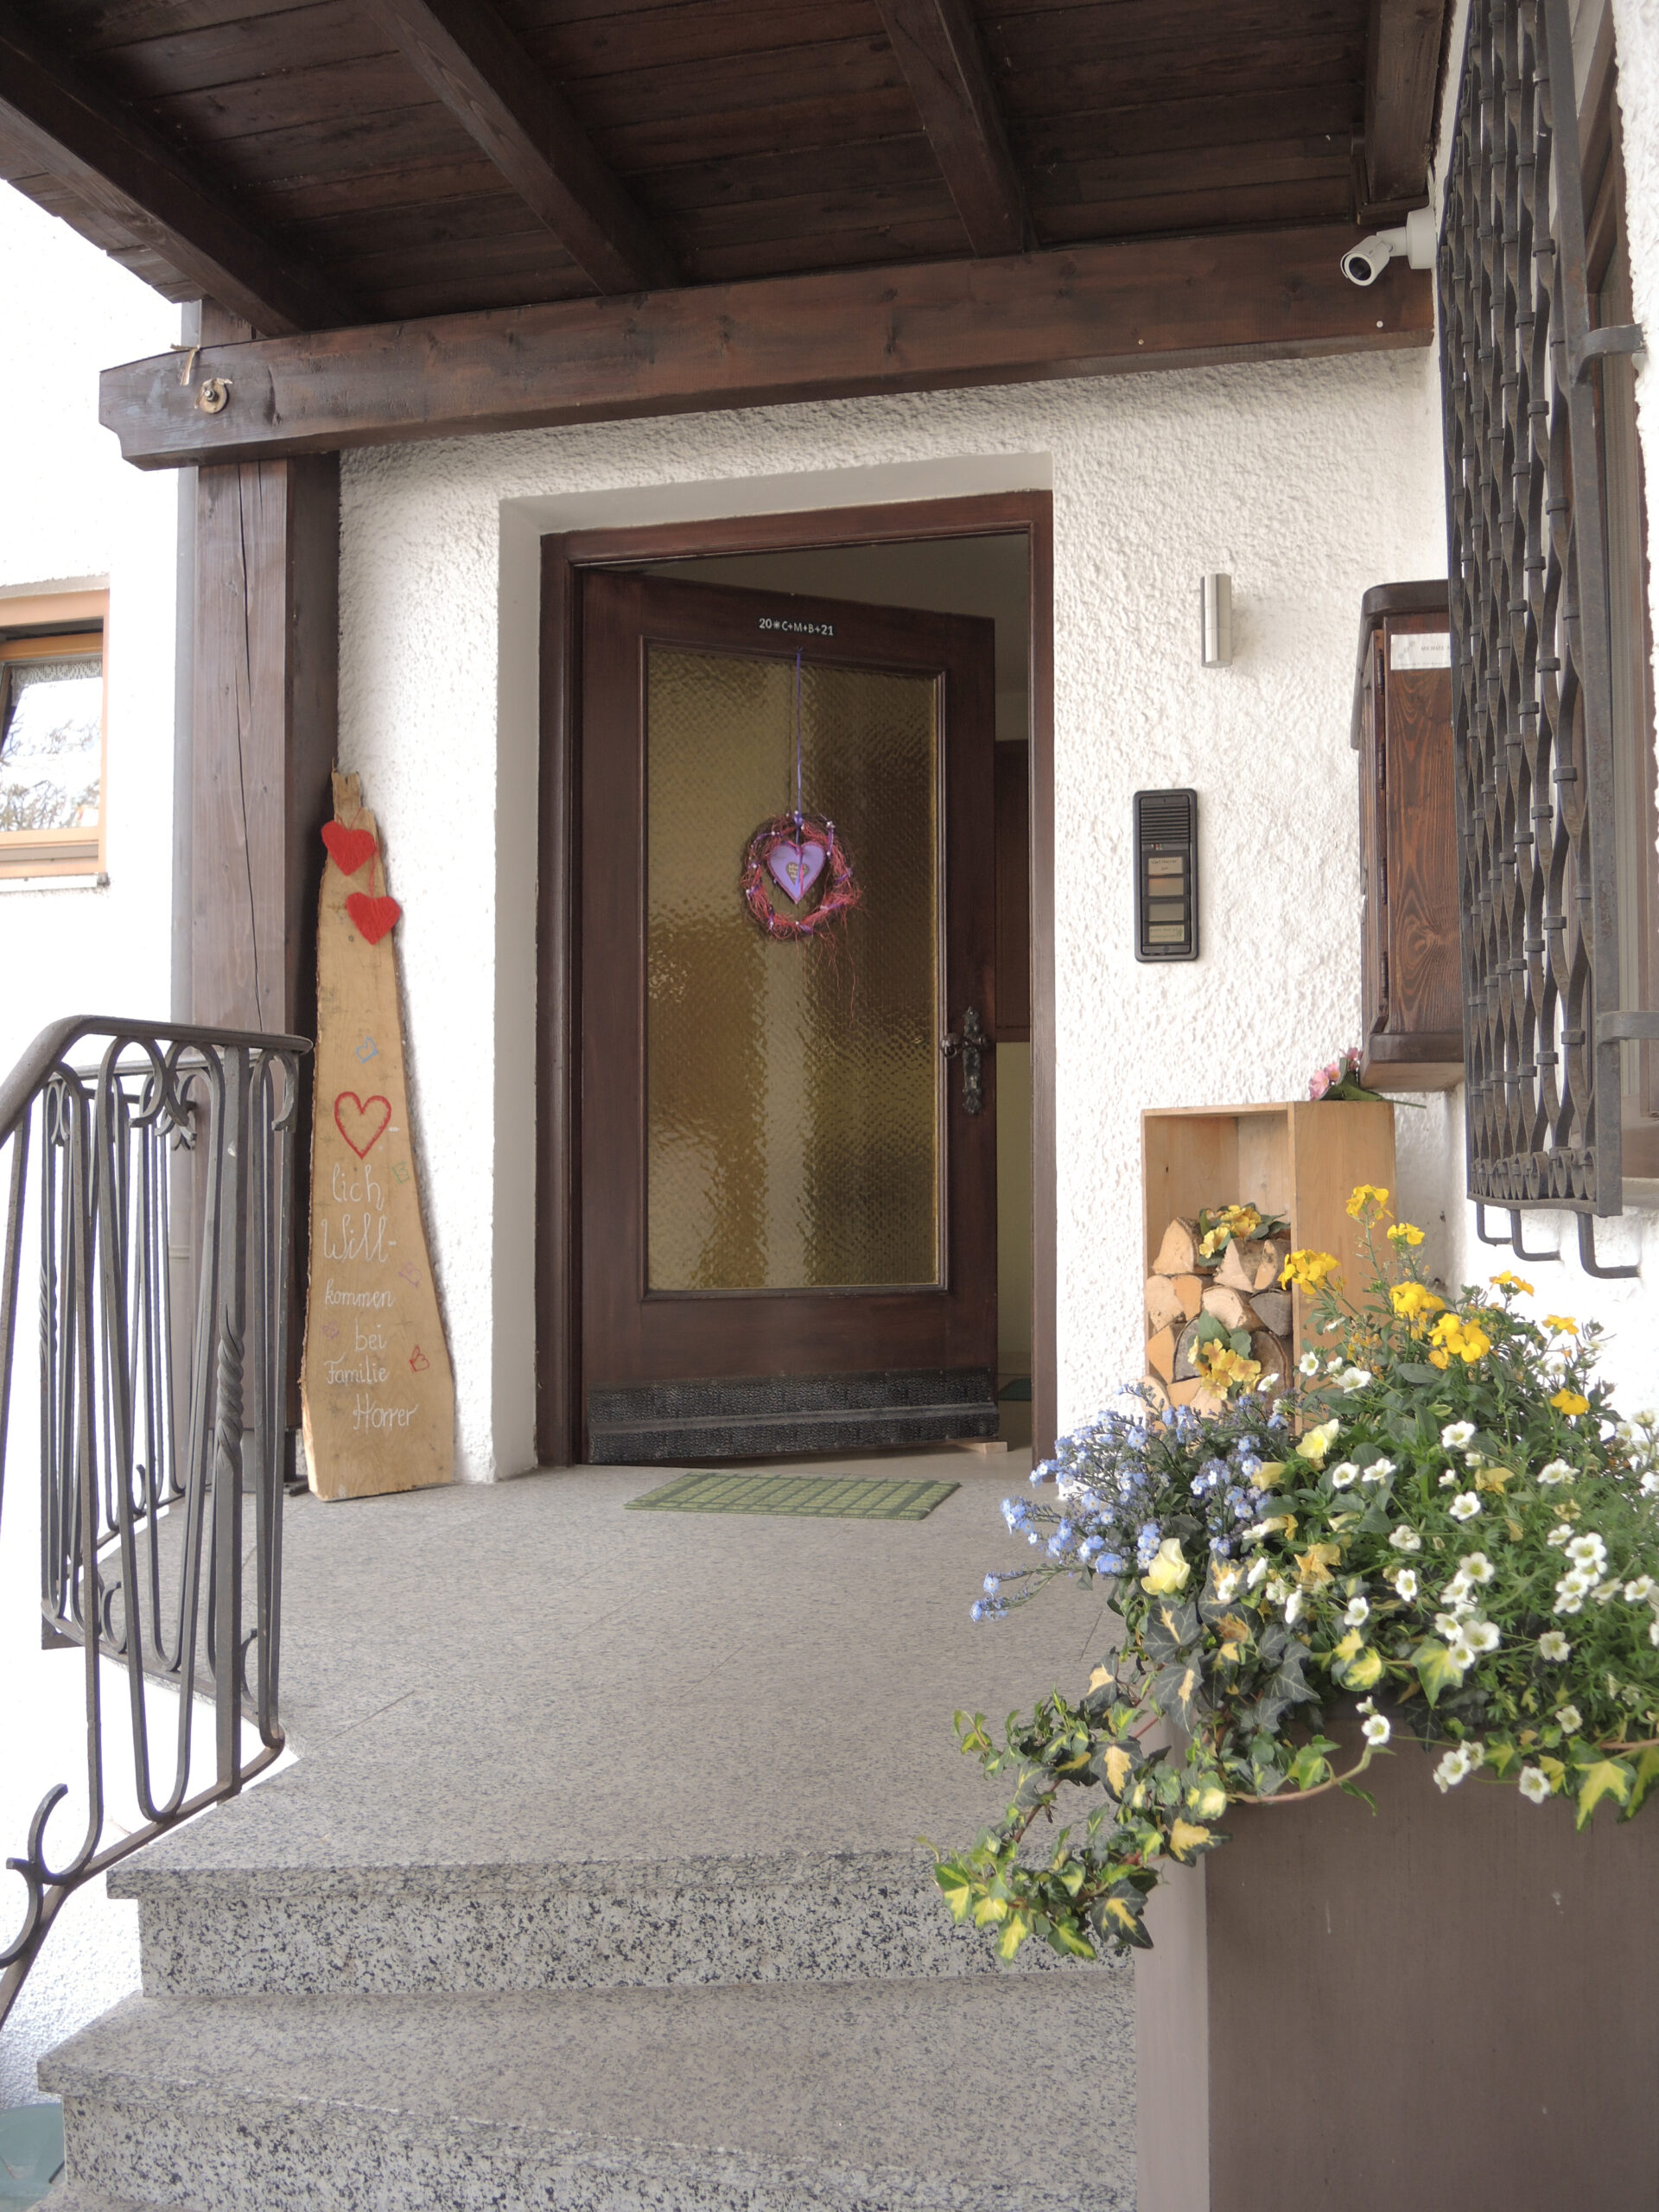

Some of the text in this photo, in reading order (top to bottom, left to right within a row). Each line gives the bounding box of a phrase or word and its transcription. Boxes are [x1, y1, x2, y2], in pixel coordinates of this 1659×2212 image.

[332, 1163, 385, 1211] lich
[321, 1212, 397, 1263] Will-
[324, 1278, 395, 1309] kommen
[354, 1318, 387, 1351] bei
[323, 1351, 390, 1386] Familie
[353, 1393, 419, 1434] Horrer
